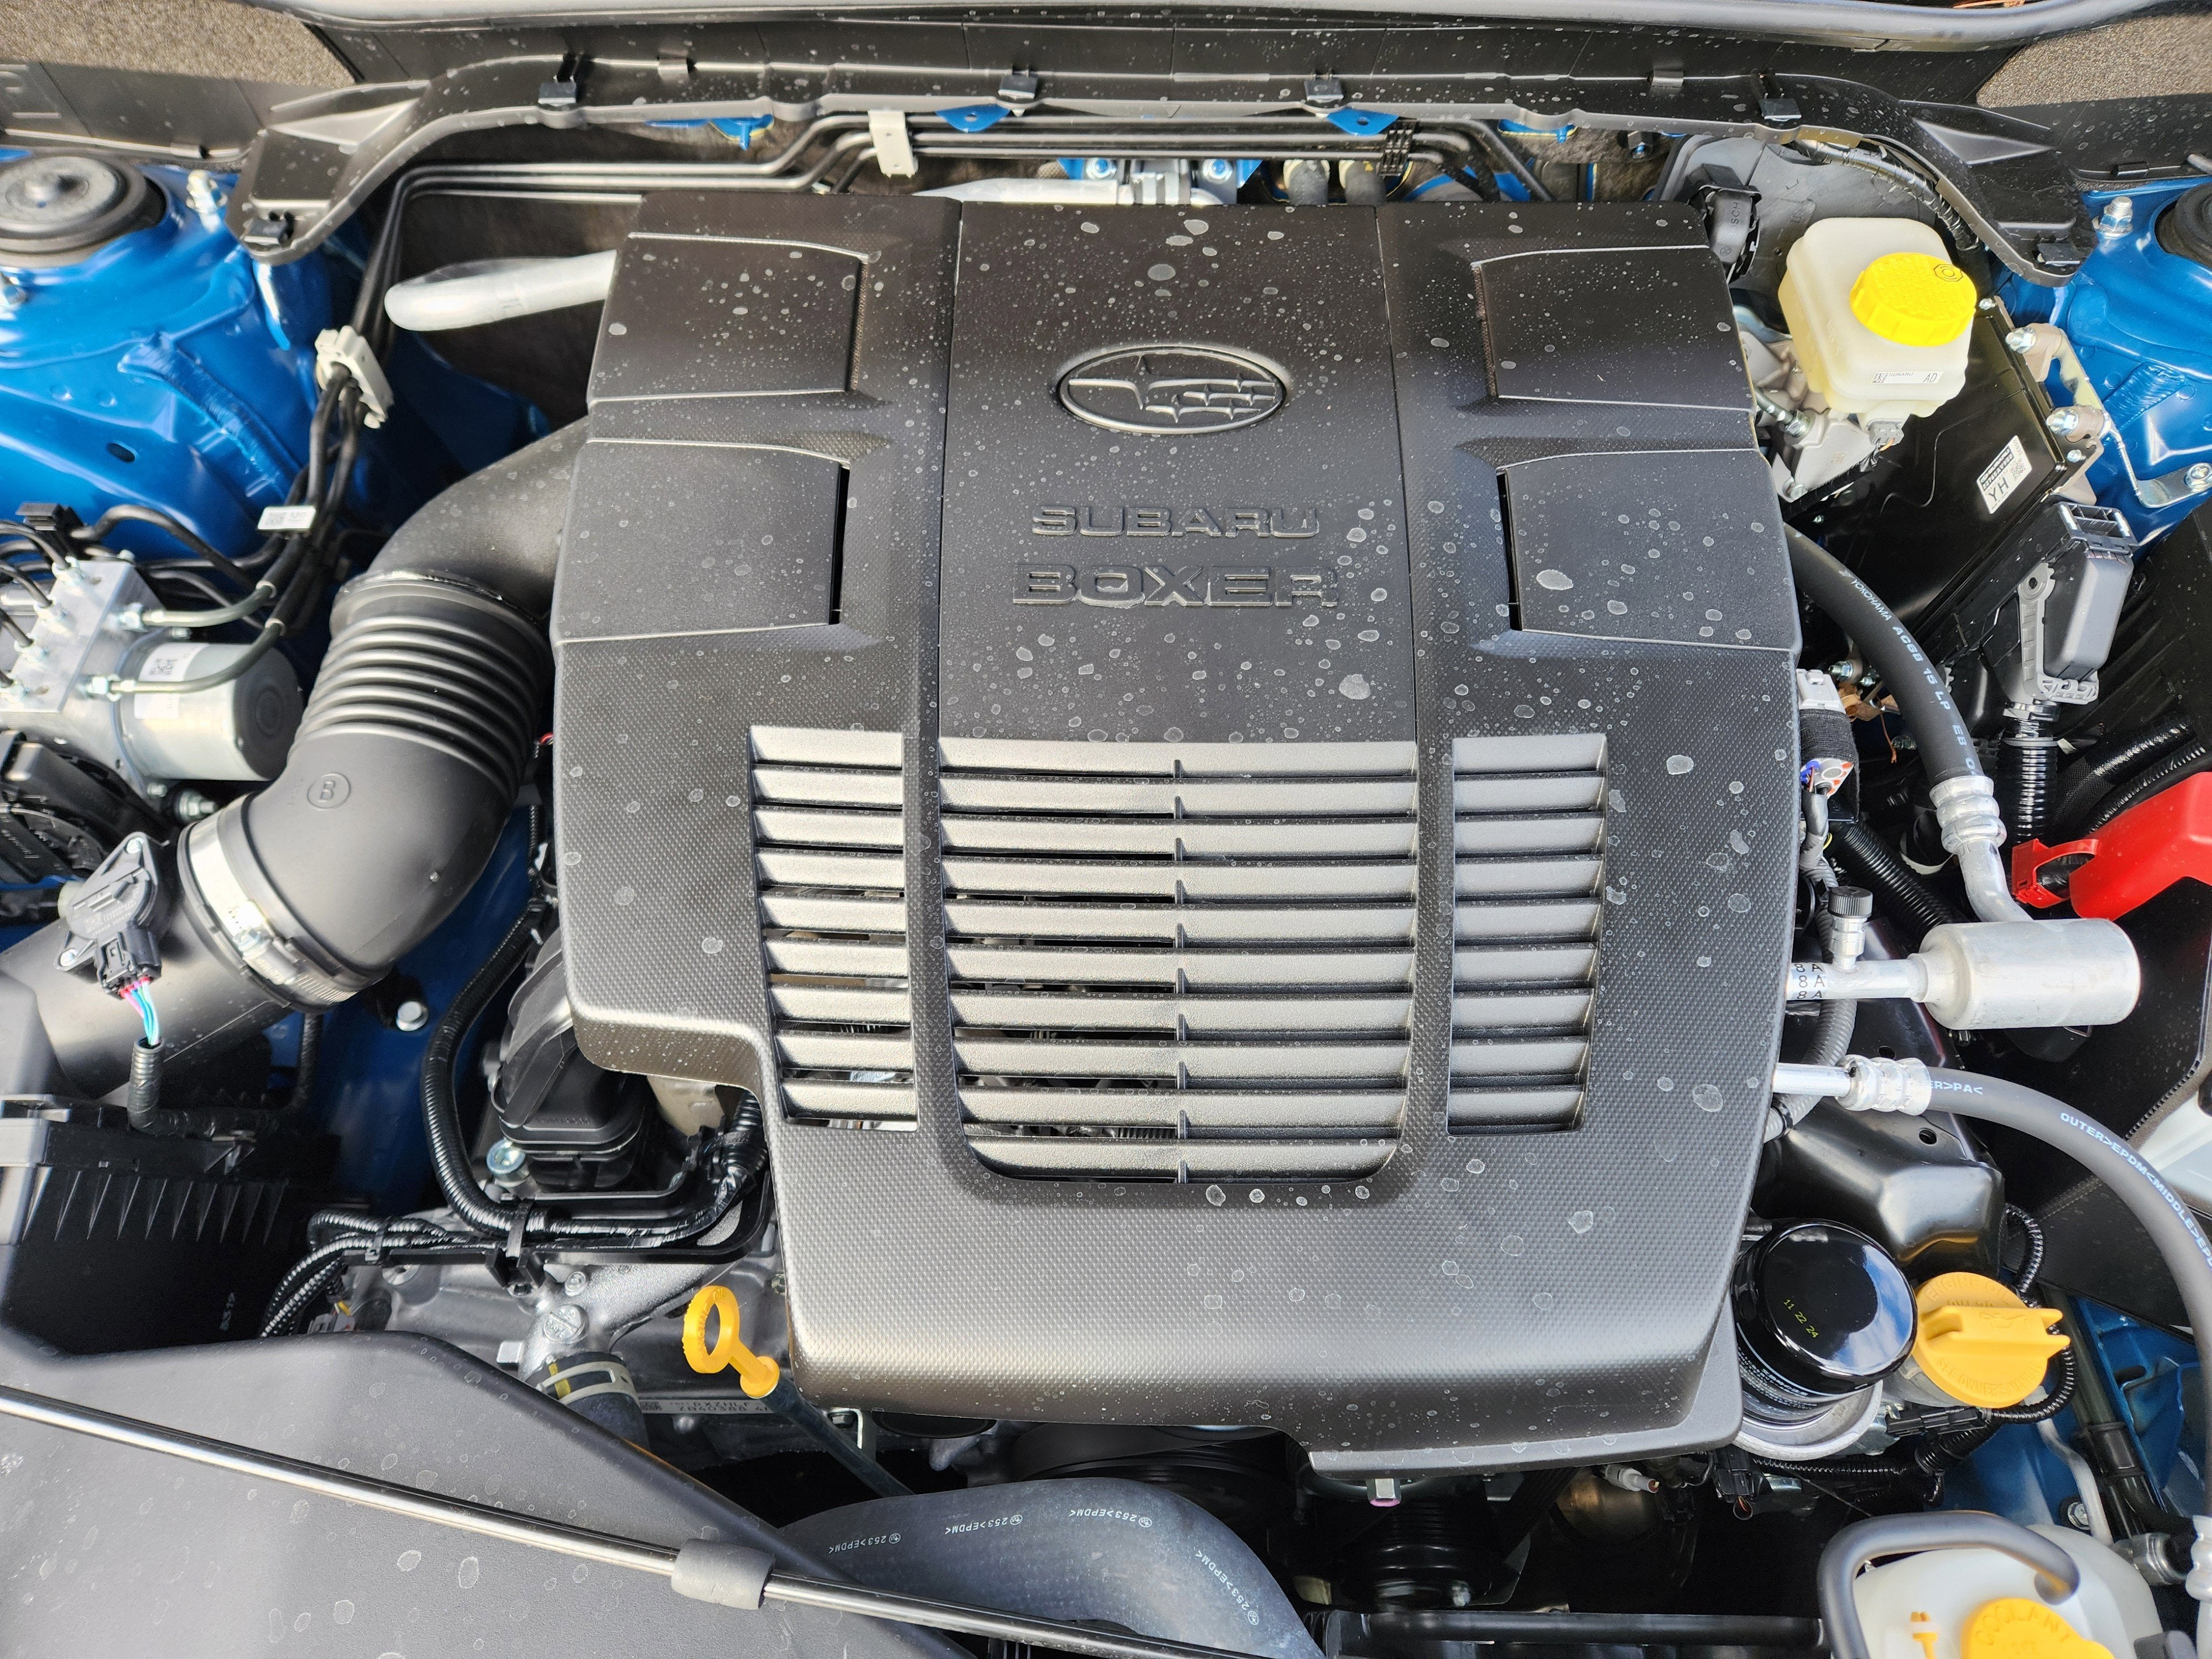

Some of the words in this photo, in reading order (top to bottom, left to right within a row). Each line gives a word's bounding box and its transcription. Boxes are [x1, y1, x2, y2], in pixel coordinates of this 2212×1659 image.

[1923, 373, 1938, 383] AD
[1988, 476, 2009, 504] YH
[1032, 505, 1320, 538] SUBARU
[1013, 564, 1339, 607] BOXER
[1850, 578, 1892, 620] YOKOHAMA
[1923, 667, 1938, 684] 15
[1935, 691, 1952, 709] LP
[1952, 724, 1967, 745] EB
[1794, 964, 1806, 972] 8
[1812, 964, 1824, 972] A
[1799, 975, 1808, 988] 8
[1814, 975, 1825, 987] A
[1926, 1276, 1978, 1302] ENGINE
[1783, 1299, 1795, 1310] 11
[1794, 1311, 1807, 1324] 22
[1806, 1325, 1819, 1338] 24
[1938, 1359, 1959, 1377] SEE
[1070, 1509, 1138, 1522] 253>EPDM<
[945, 1517, 1008, 1535] 253>EPDM<
[828, 1535, 887, 1554] 253>EPDM<
